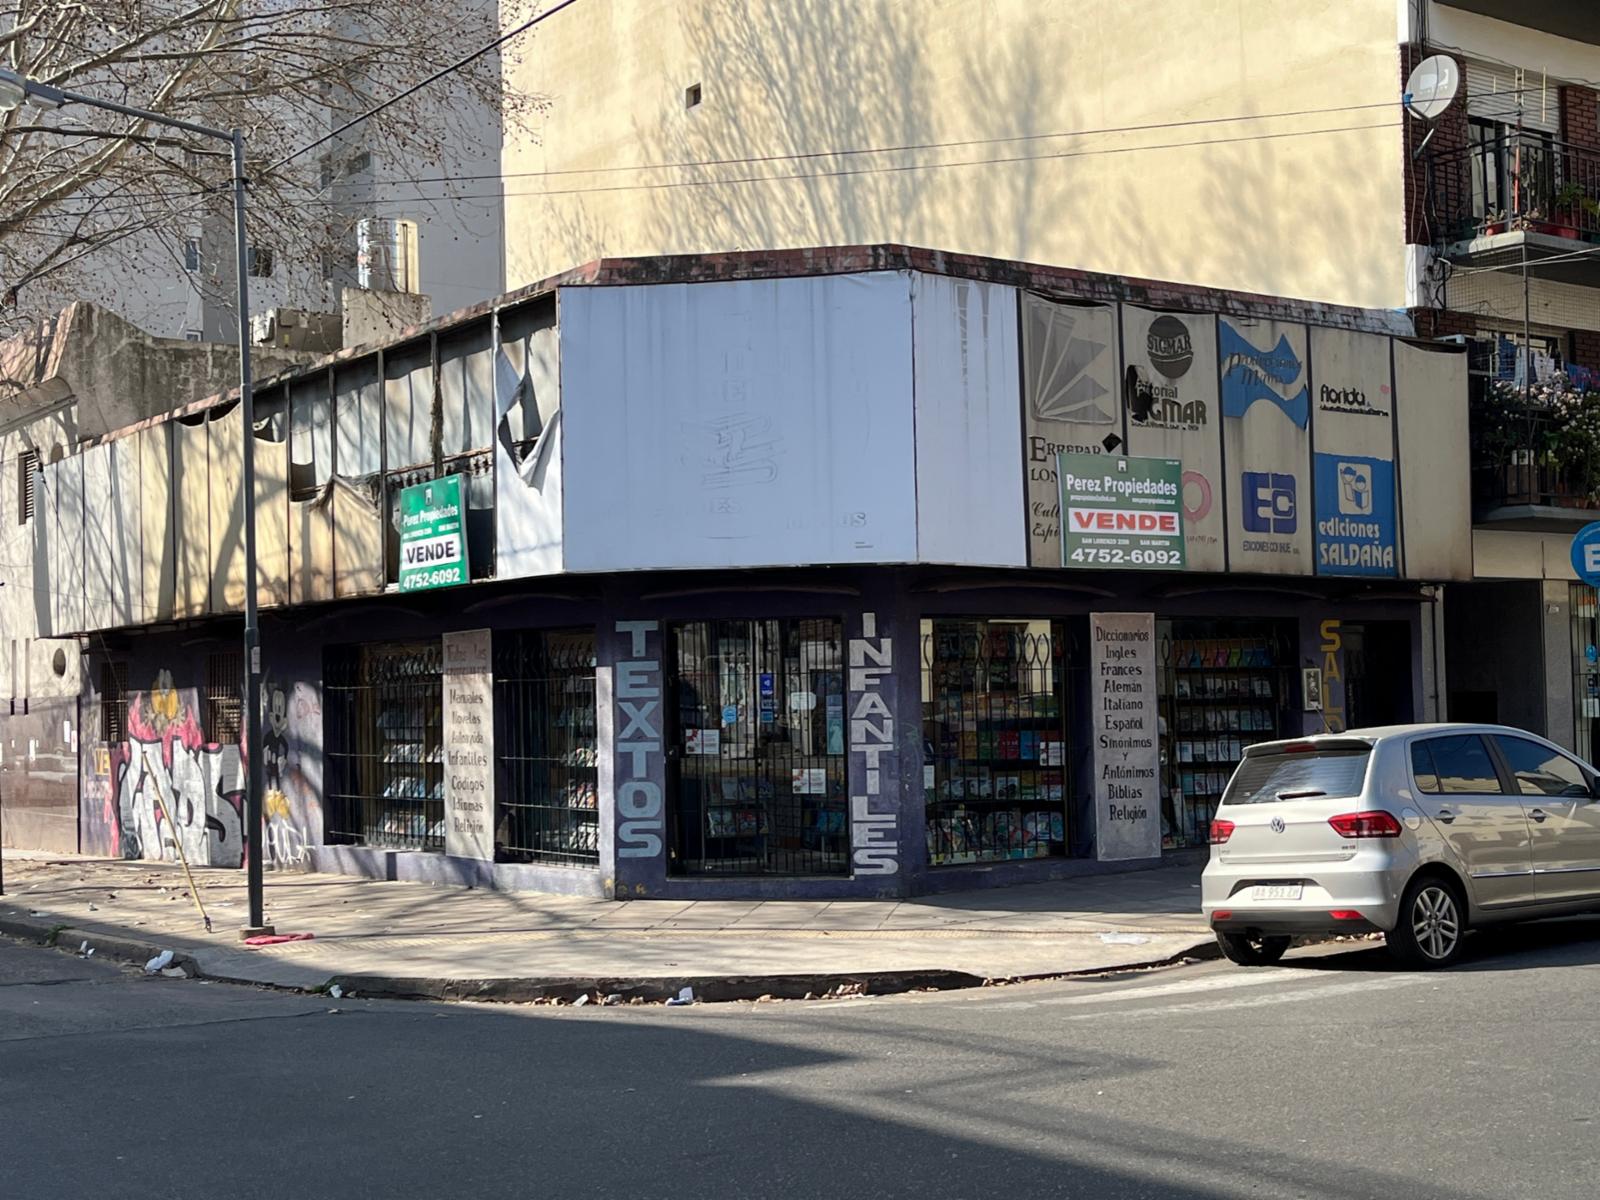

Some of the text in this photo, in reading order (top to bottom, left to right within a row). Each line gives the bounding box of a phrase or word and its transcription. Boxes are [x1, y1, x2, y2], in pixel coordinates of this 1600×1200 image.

[1147, 333, 1192, 355] SIGMAR
[1066, 474, 1177, 497] Perez Propiedades
[1074, 511, 1176, 532] VENDE
[1319, 518, 1380, 539] ediciones
[406, 541, 455, 564] VENDE
[1071, 548, 1181, 565] 4752-6092
[1320, 541, 1394, 569] SALDAÑA
[403, 567, 460, 590] 4752-6092
[1096, 626, 1149, 642] Diccionarios
[1103, 697, 1143, 711] Italiano
[1104, 714, 1144, 732] Español
[615, 620, 662, 859] TEXTOS
[849, 612, 899, 876] INFANTILES
[448, 750, 488, 767] Infantiles
[1102, 764, 1155, 780] Antónimos
[1107, 783, 1143, 800] Biblias
[1109, 804, 1147, 825] Religión
